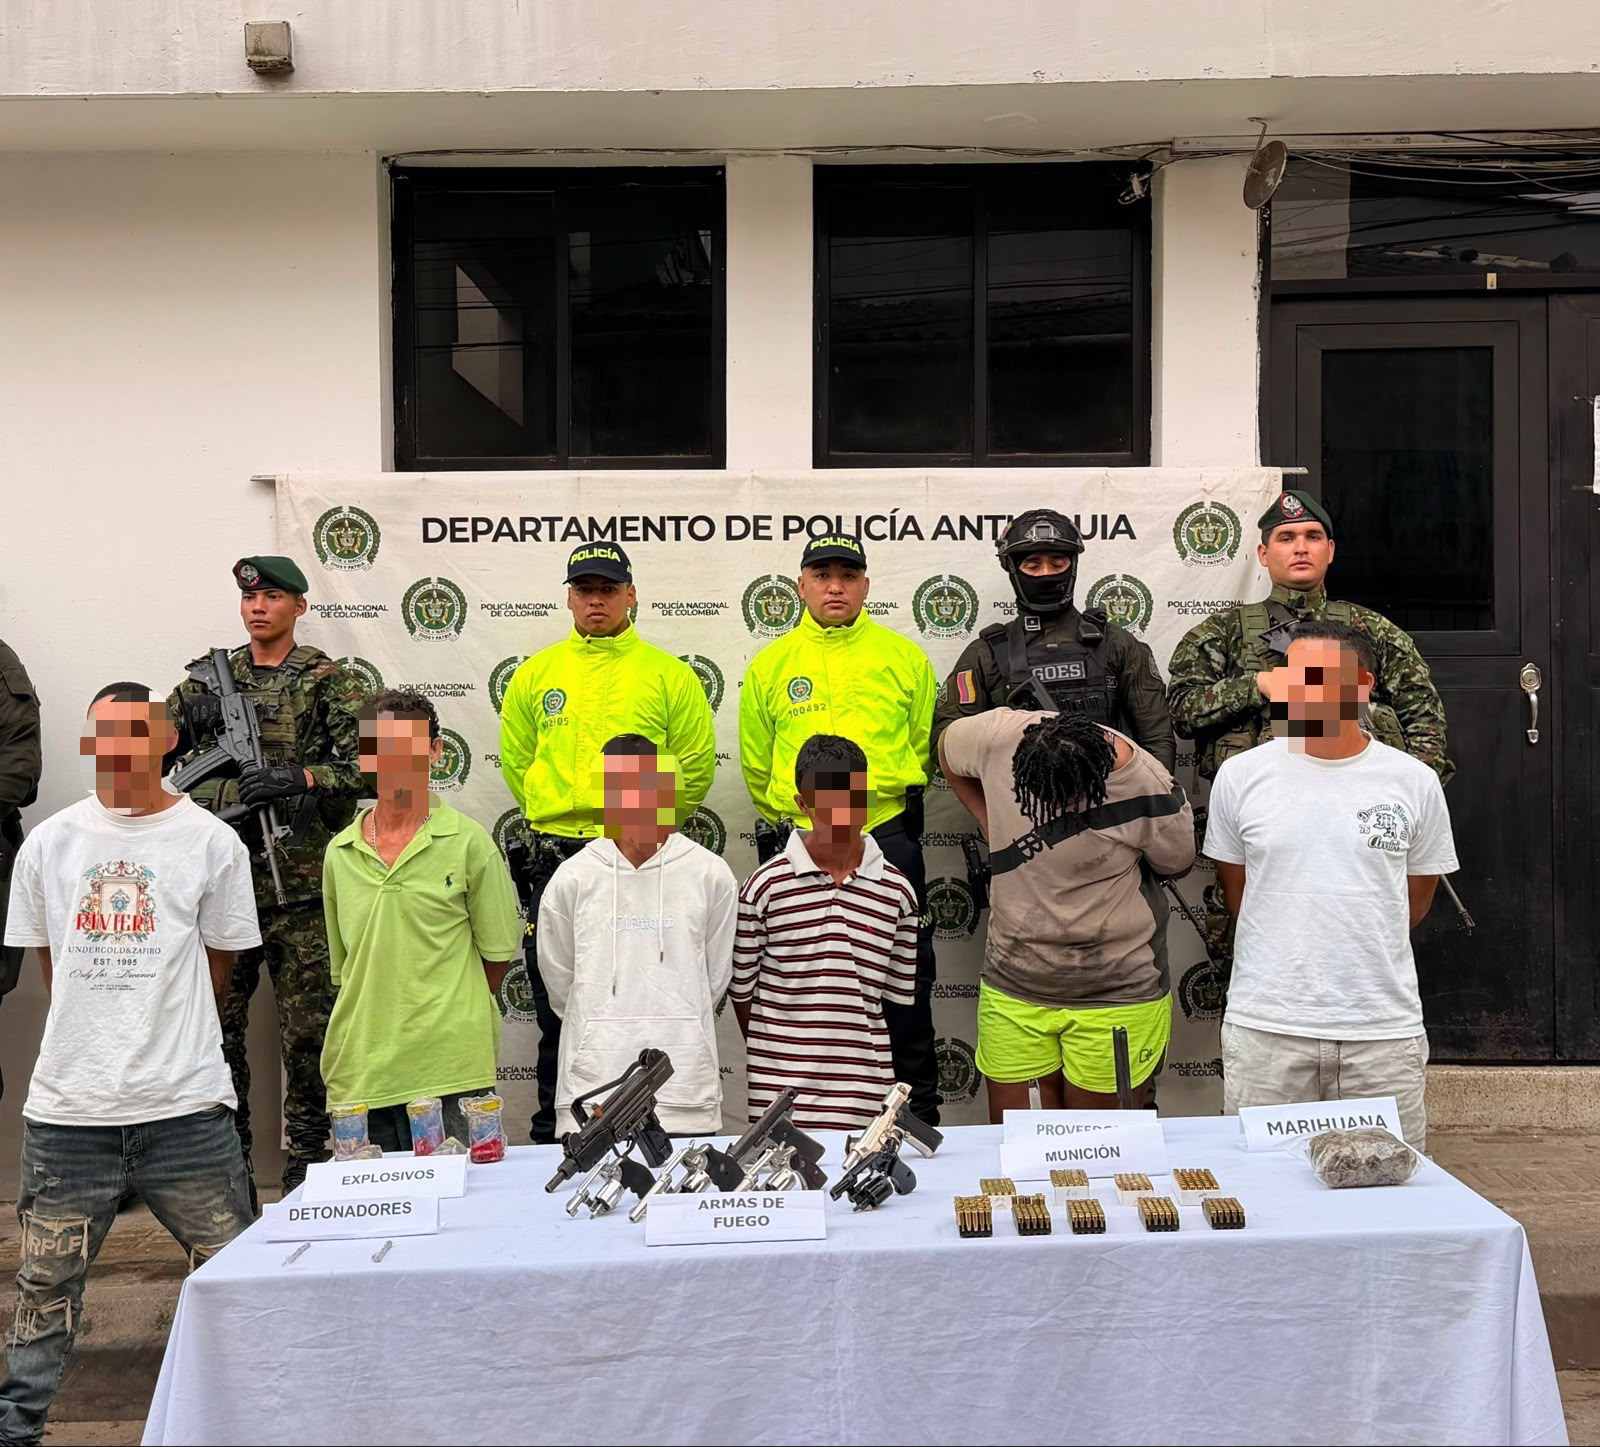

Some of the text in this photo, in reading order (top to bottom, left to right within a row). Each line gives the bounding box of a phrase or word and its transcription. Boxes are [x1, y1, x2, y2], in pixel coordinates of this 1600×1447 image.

[422, 508, 1137, 543] DEPARTAMENTO DE POLICÍA ANTUIA
[810, 536, 861, 554] POLICÍA
[569, 547, 621, 565] POLICÍA
[310, 603, 389, 612] POLICÍA NACIONAL
[480, 602, 559, 611] POLICÍA NACIONAL
[652, 600, 730, 610] POLICÍA NACIONAL
[1167, 600, 1202, 608] POLICÍA
[320, 611, 379, 619] DE COLOMBIA
[490, 609, 549, 618] DE COLOMBIA
[675, 609, 721, 617] COLOMBIA
[1177, 607, 1190, 615] DE
[1031, 663, 1082, 682] GOES
[399, 682, 477, 691] POLICÍA NACIONAL
[422, 690, 466, 698] COLOMBIA
[921, 832, 942, 840] LICÍA
[75, 911, 156, 933] RIVIERA
[934, 991, 979, 999] COLOMBIA
[496, 1073, 509, 1081] DE
[1267, 1115, 1388, 1136] MARIHUANA
[1045, 1143, 1120, 1162] MUNICIÓN
[341, 1168, 435, 1186] EXPLOSIVOS
[698, 1197, 785, 1210] ARMAS DE
[289, 1201, 412, 1221] DETONADORES
[713, 1215, 770, 1228] FUEGO
